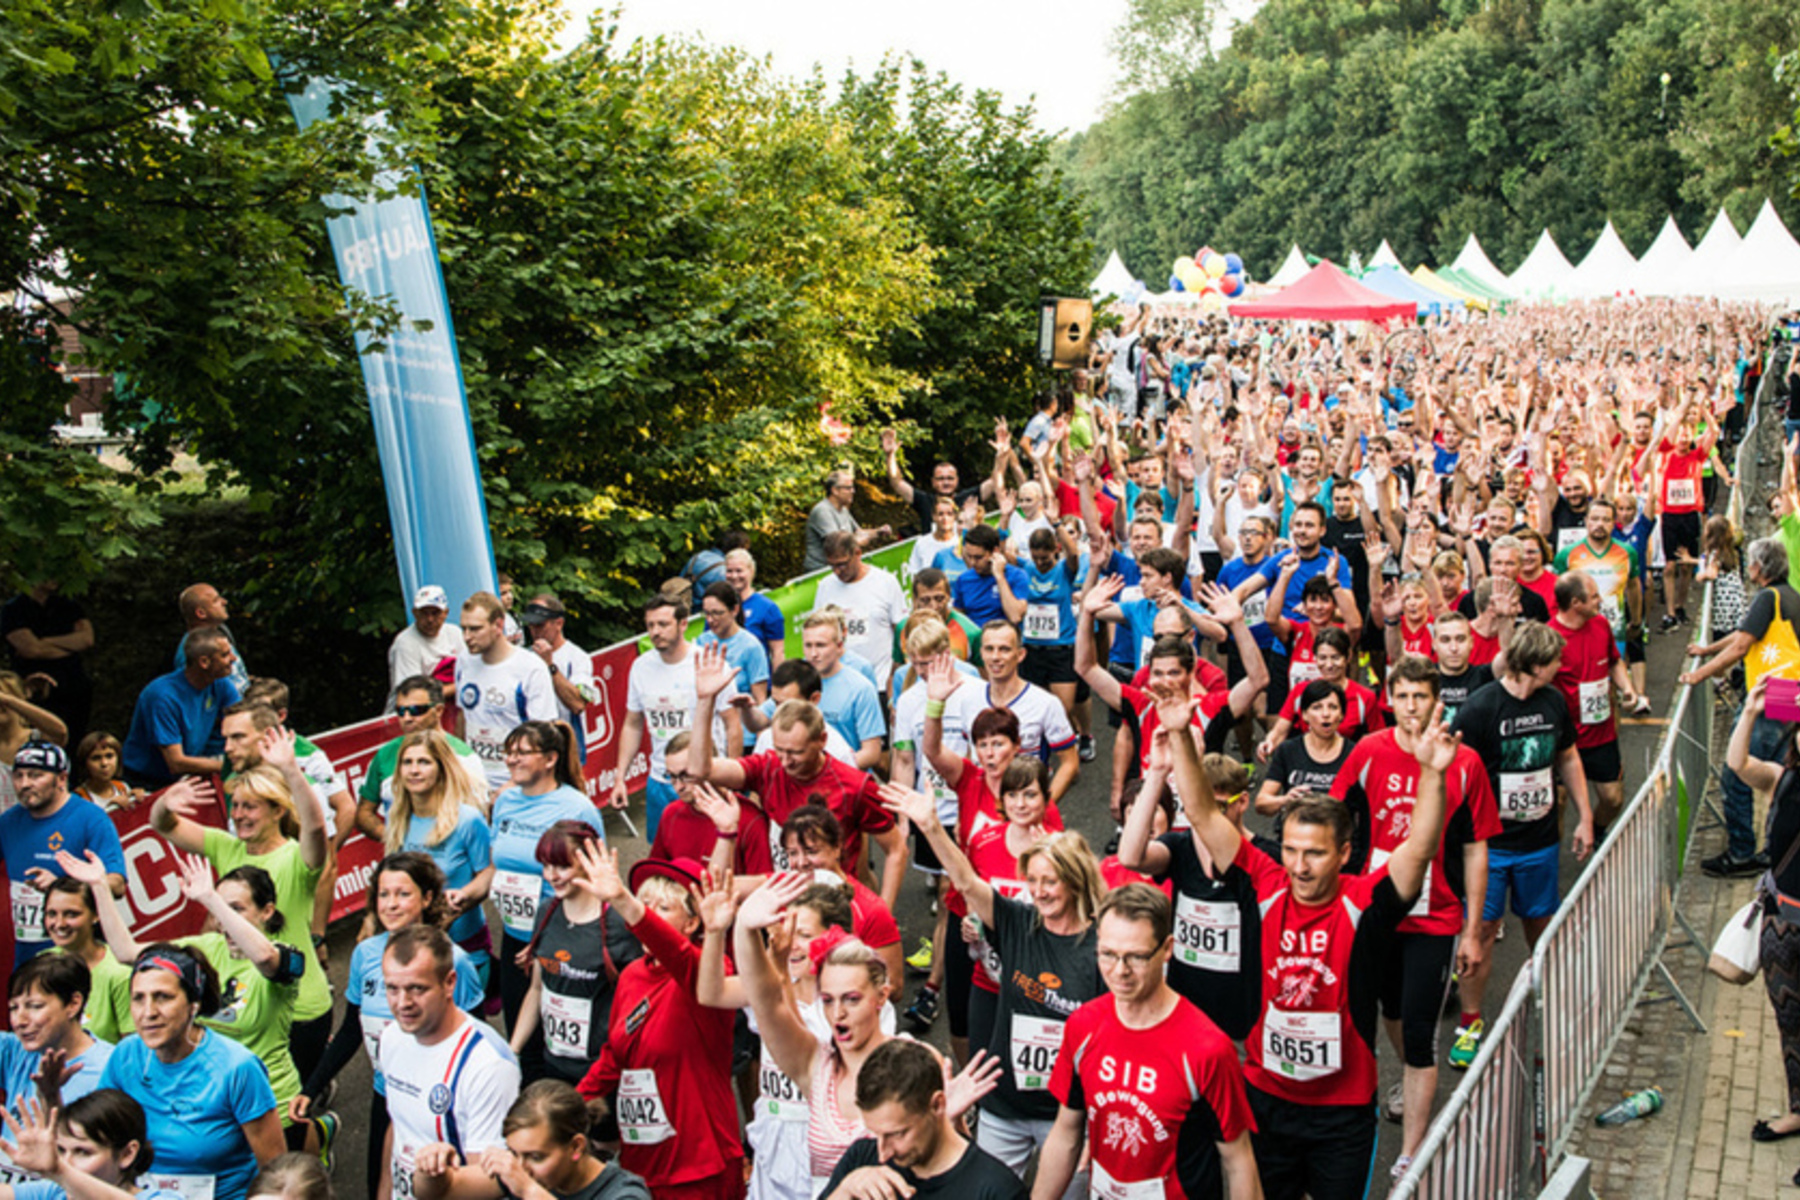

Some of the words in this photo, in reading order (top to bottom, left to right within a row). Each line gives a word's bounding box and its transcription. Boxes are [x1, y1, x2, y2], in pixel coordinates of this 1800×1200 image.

[650, 710, 684, 728] 5167
[1508, 788, 1549, 811] 6342
[1179, 919, 1229, 952] 3961
[1280, 929, 1328, 953] SIB
[1269, 1032, 1329, 1066] 6651
[1098, 1055, 1158, 1094] SIB
[620, 1097, 660, 1124] 4042
[1094, 1089, 1170, 1143] Bewegung
